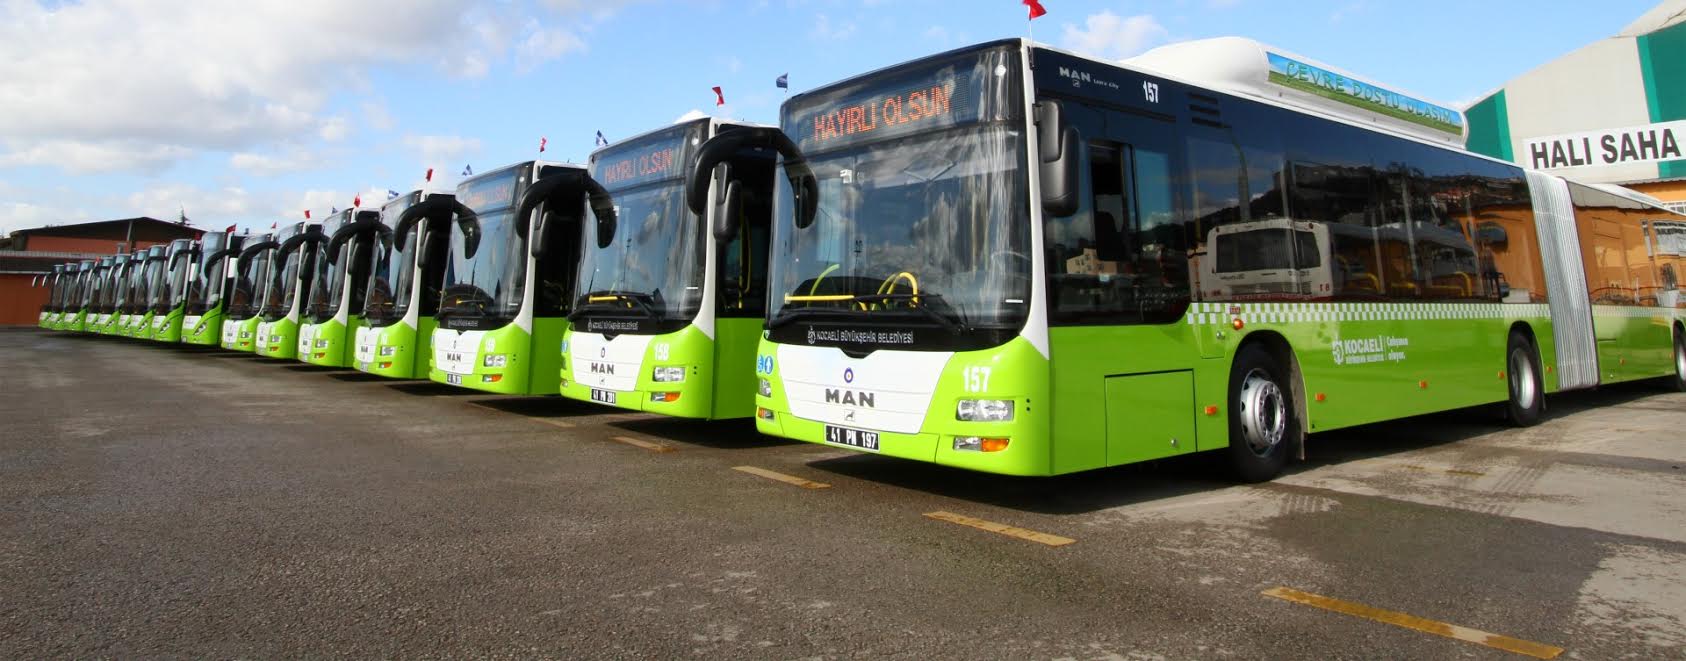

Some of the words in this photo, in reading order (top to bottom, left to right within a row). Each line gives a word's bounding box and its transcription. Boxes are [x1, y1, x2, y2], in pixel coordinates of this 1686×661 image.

[1059, 66, 1091, 82] MAN
[1143, 80, 1159, 104] 157
[1286, 62, 1345, 92] ÇEVRE
[1352, 82, 1400, 108] DOSTU
[814, 102, 877, 142] HAYIRLI
[882, 84, 950, 127] OLSUN
[1530, 137, 1593, 170] HALI
[1600, 128, 1682, 164] SAHA
[816, 330, 840, 341] KOCAELİ
[877, 331, 914, 344] BELEDİYESİ
[1344, 335, 1384, 354] KOCAELİ
[446, 353, 462, 362] MAN
[654, 343, 669, 361] 158
[591, 362, 614, 375] MAN
[962, 365, 991, 393] 157
[825, 388, 875, 408] MAN
[830, 427, 841, 442] 41
[846, 430, 857, 446] PN
[861, 432, 877, 450] 197
